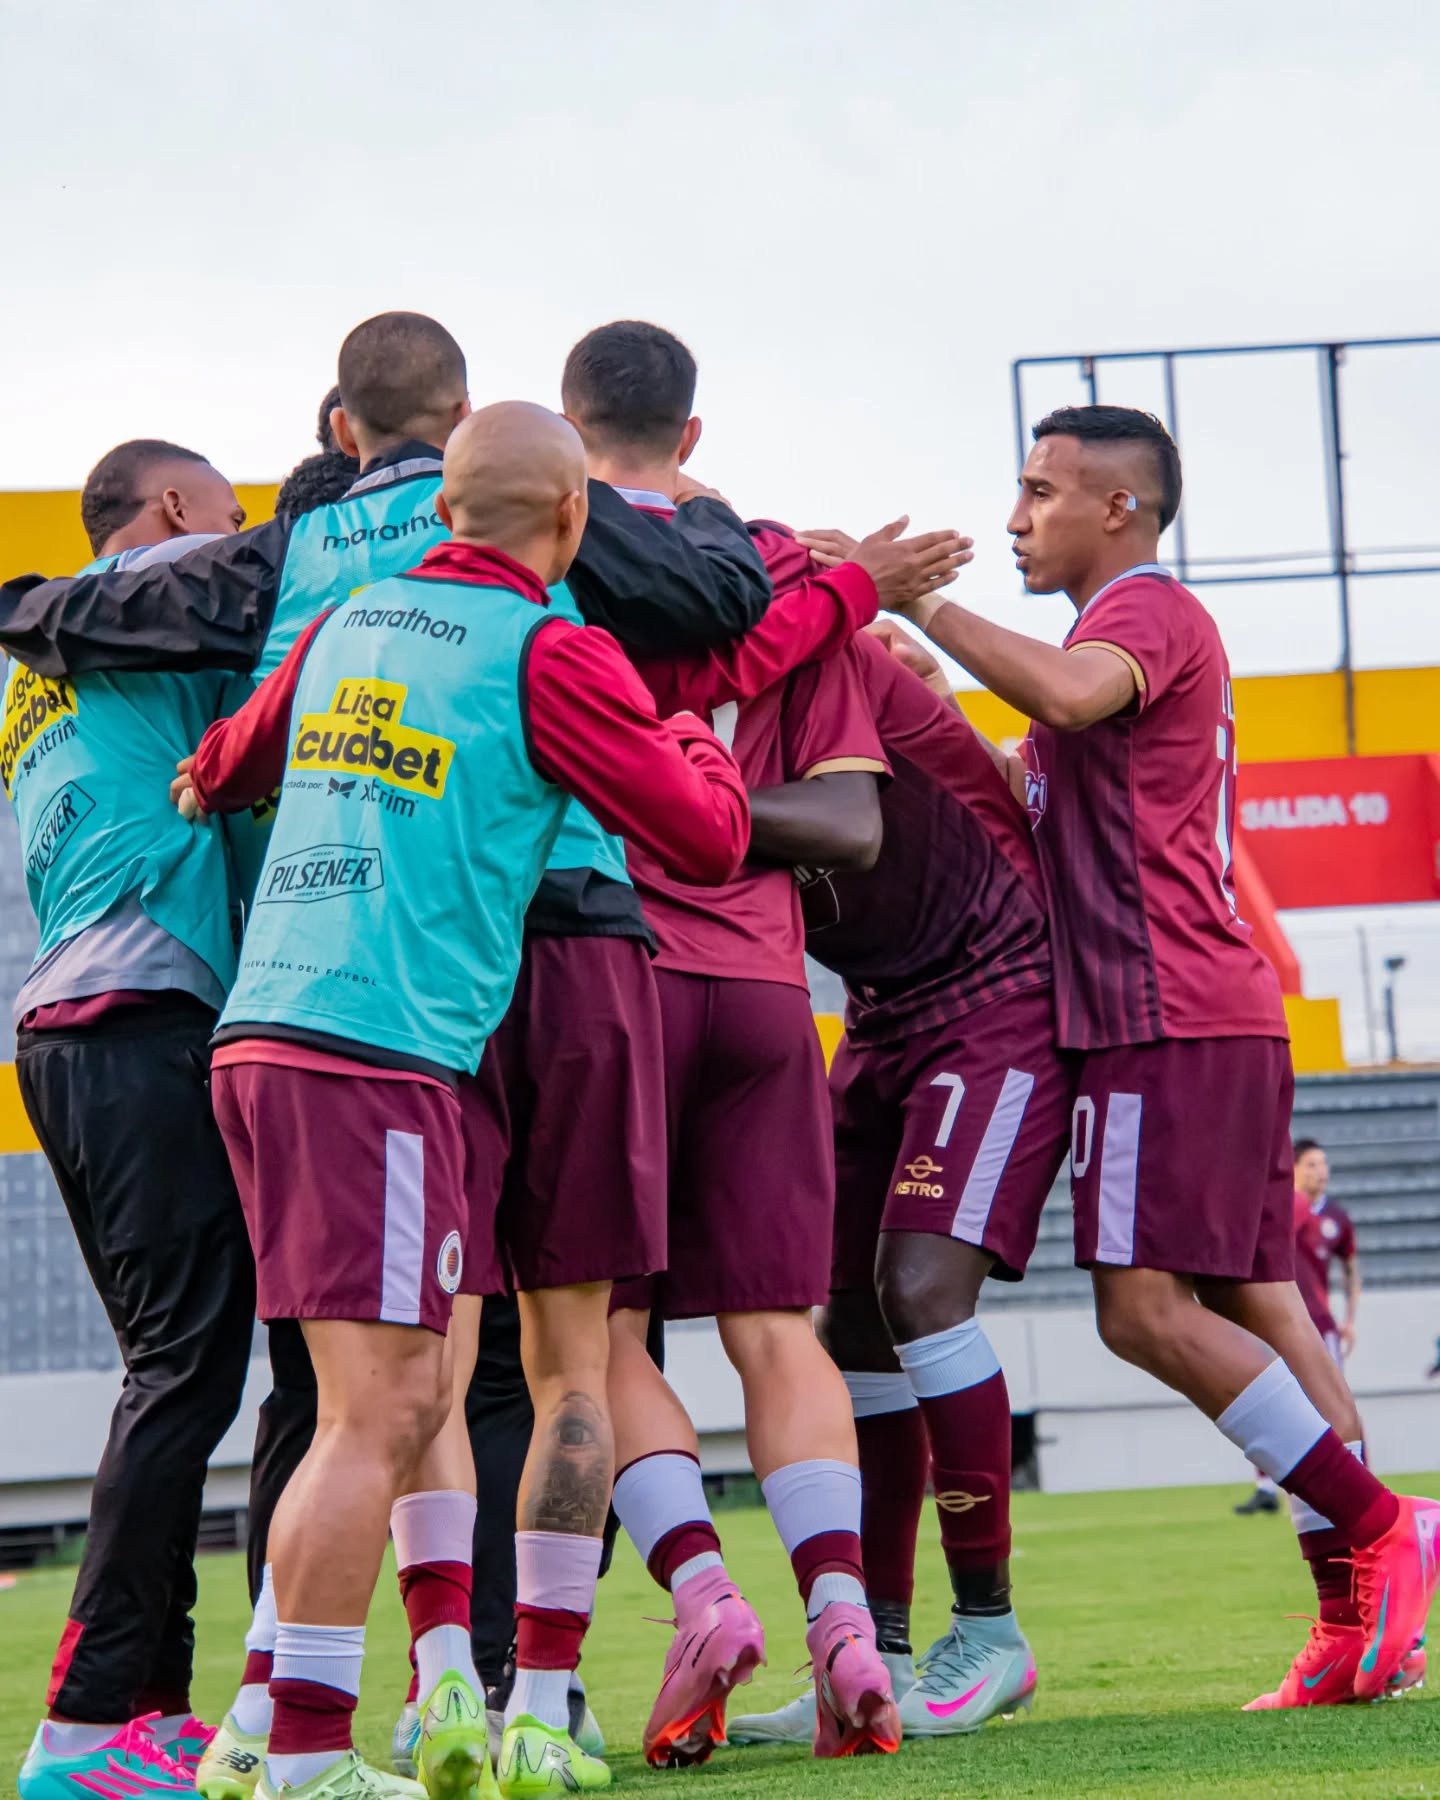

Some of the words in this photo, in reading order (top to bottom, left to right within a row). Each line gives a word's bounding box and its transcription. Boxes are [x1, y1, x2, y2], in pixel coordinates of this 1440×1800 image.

[322, 512, 445, 552] maratho
[343, 607, 467, 646] marathon
[334, 685, 397, 726] Liga
[292, 722, 441, 789] cuabet
[339, 778, 416, 818] xtrim
[1240, 795, 1347, 830] SALIDA
[1350, 792, 1388, 824] 10
[266, 857, 373, 897] PILSENER
[271, 960, 293, 970] ERA
[297, 963, 319, 974] DEL
[930, 1071, 966, 1149] 7
[894, 1181, 945, 1199] ASTRO
